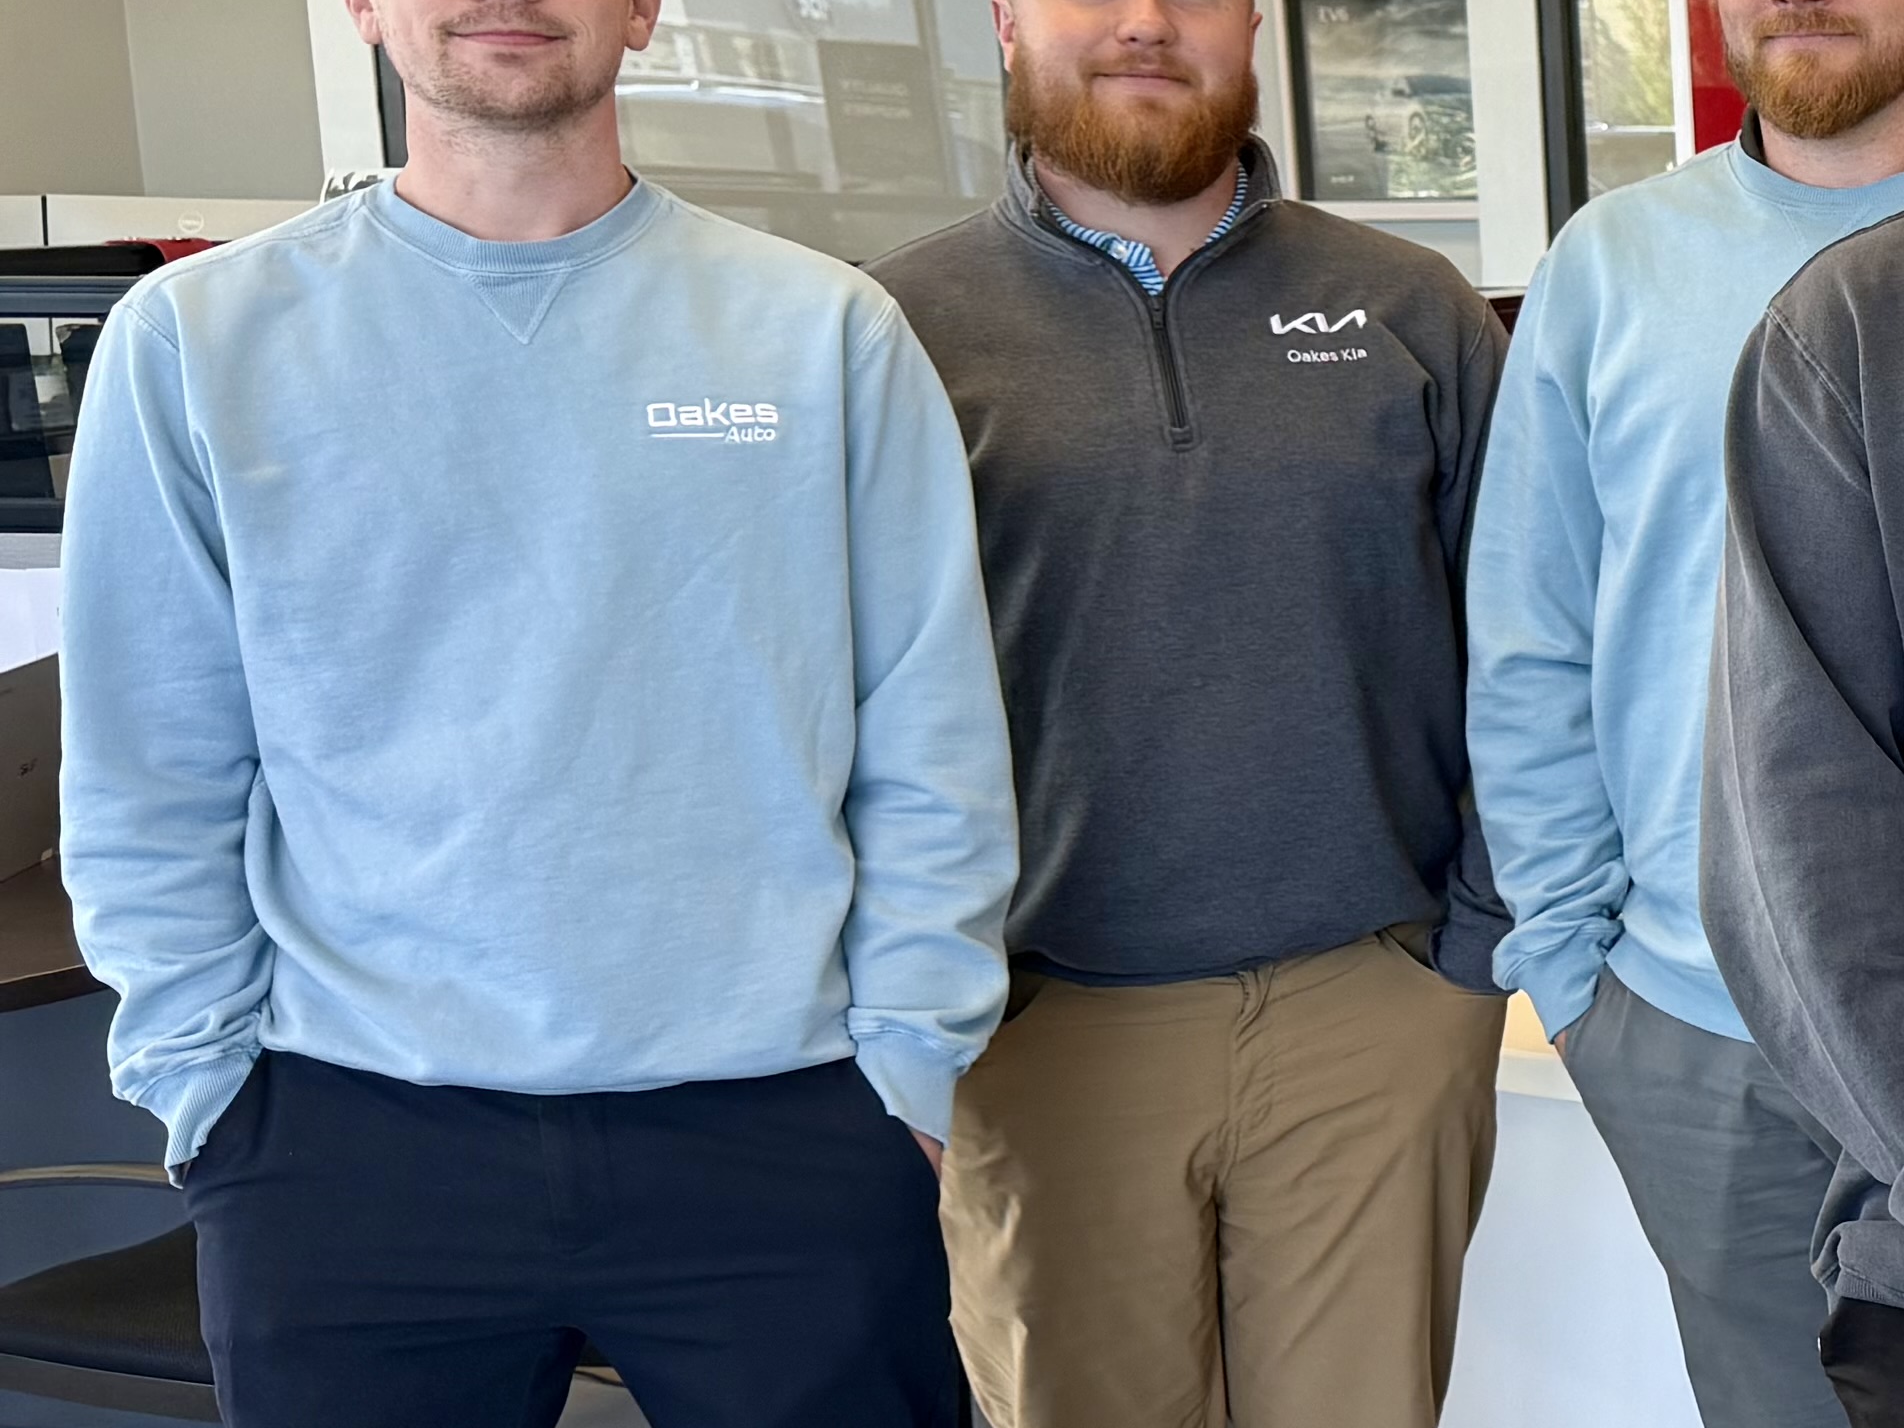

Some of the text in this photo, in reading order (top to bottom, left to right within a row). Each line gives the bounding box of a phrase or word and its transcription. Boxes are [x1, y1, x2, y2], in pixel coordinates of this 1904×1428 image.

[1287, 349, 1339, 363] Oakes
[646, 397, 779, 427] Oakes
[724, 426, 777, 444] Auto
